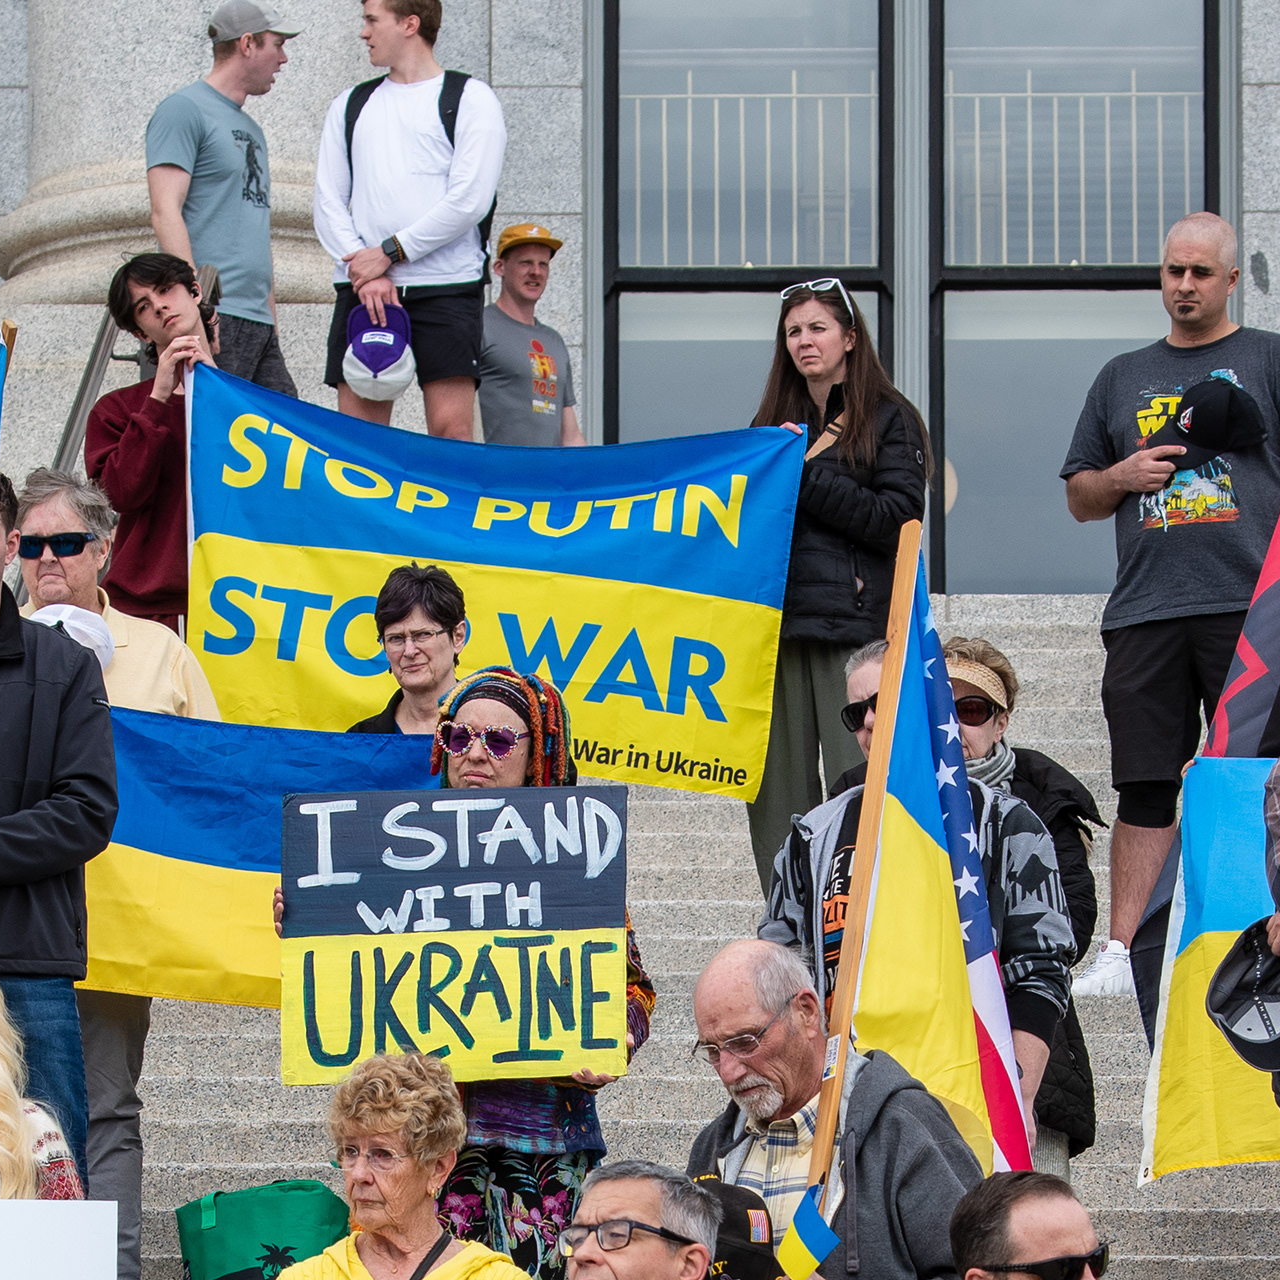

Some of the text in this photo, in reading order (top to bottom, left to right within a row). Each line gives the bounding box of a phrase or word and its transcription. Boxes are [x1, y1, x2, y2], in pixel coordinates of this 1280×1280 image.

[532, 380, 557, 399] 70.3
[221, 413, 748, 549] STOP PUTIN
[203, 575, 728, 724] STO WAR
[573, 738, 748, 786] War in Ukraine
[297, 796, 623, 889] I STAND
[356, 881, 544, 934] WITH
[302, 934, 619, 1068] UKRAINE
